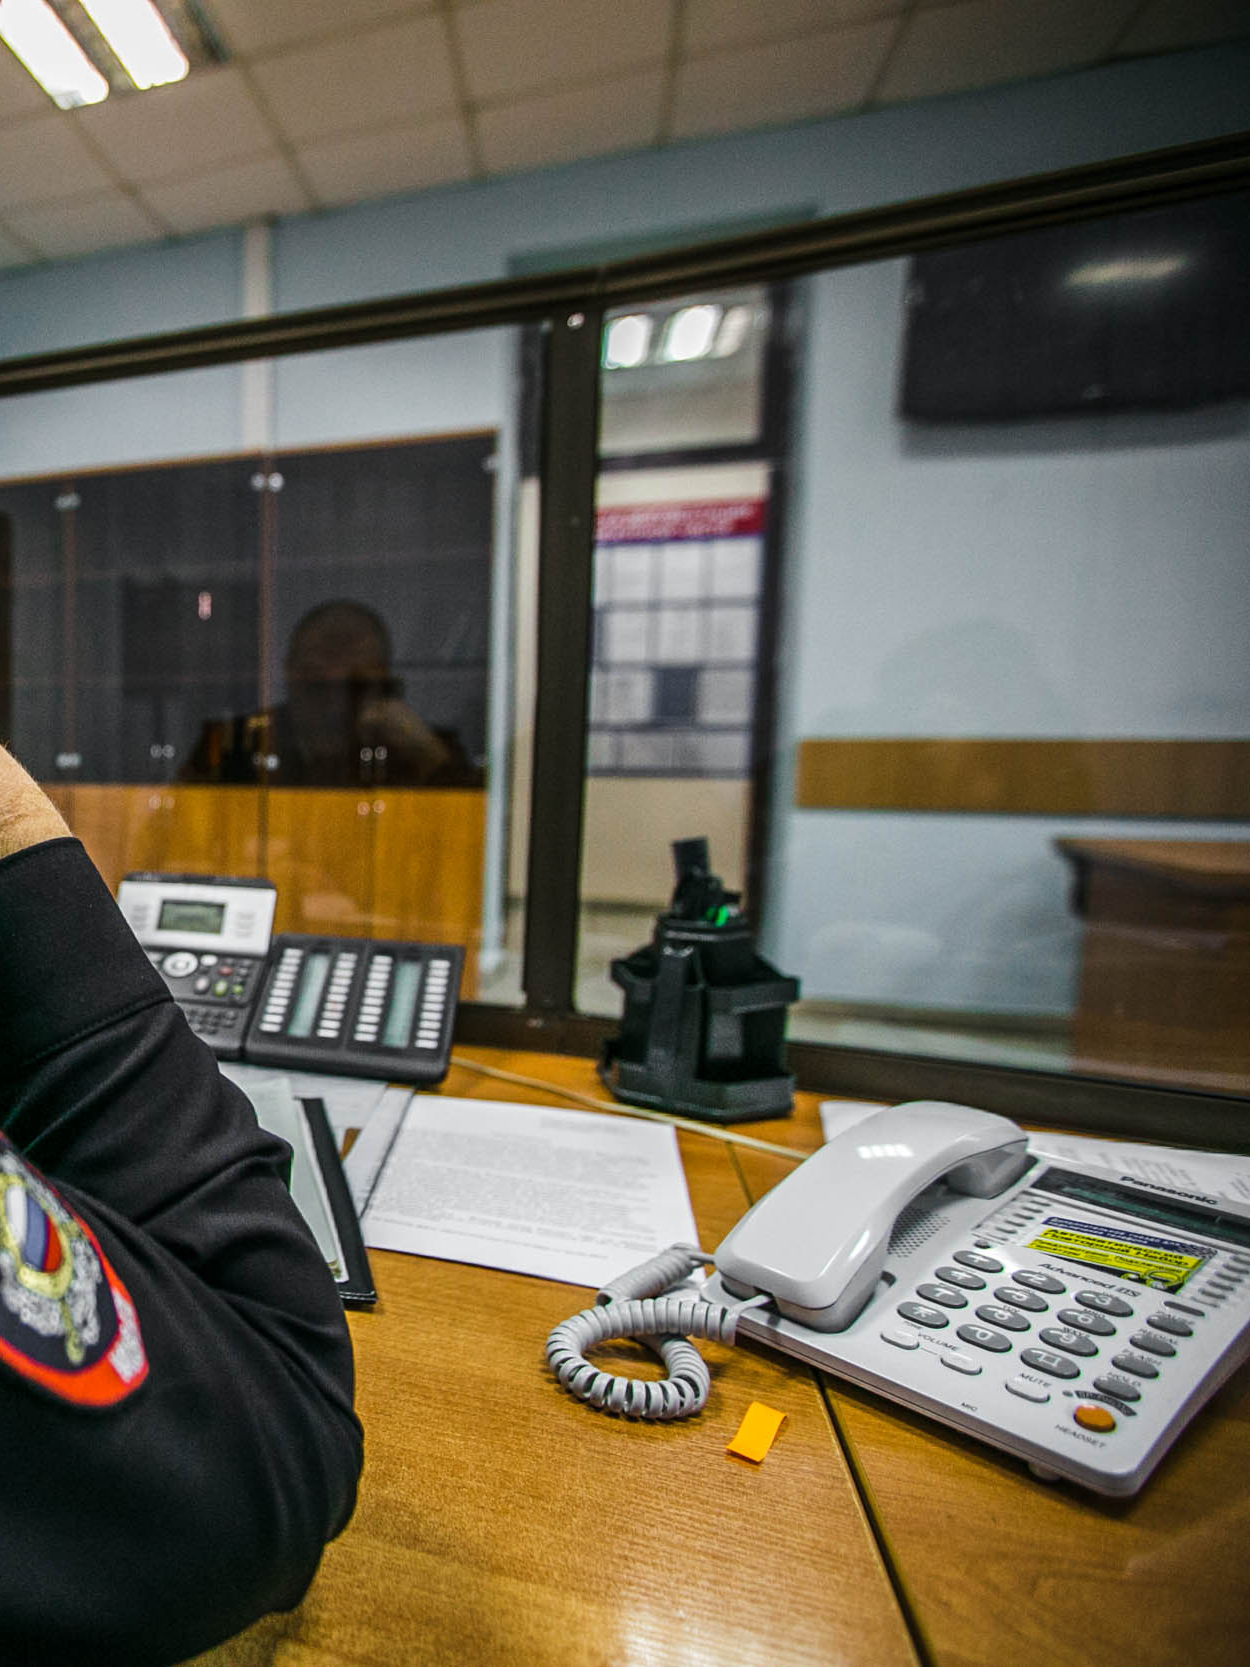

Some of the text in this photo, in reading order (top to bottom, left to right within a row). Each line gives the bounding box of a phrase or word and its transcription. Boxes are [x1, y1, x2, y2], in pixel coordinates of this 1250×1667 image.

[1121, 1175, 1217, 1205] Panasonic
[1135, 1250, 1189, 1267] Набор
[1038, 1263, 1117, 1290] Advanced
[1094, 1294, 1112, 1306] 3
[1078, 1313, 1094, 1325] 6
[918, 1333, 959, 1351] VOLUME
[1060, 1332, 1077, 1344] 9
[1019, 1372, 1052, 1388] MUTE
[1106, 1371, 1142, 1388] HOLD
[1054, 1423, 1107, 1448] HEADSET
